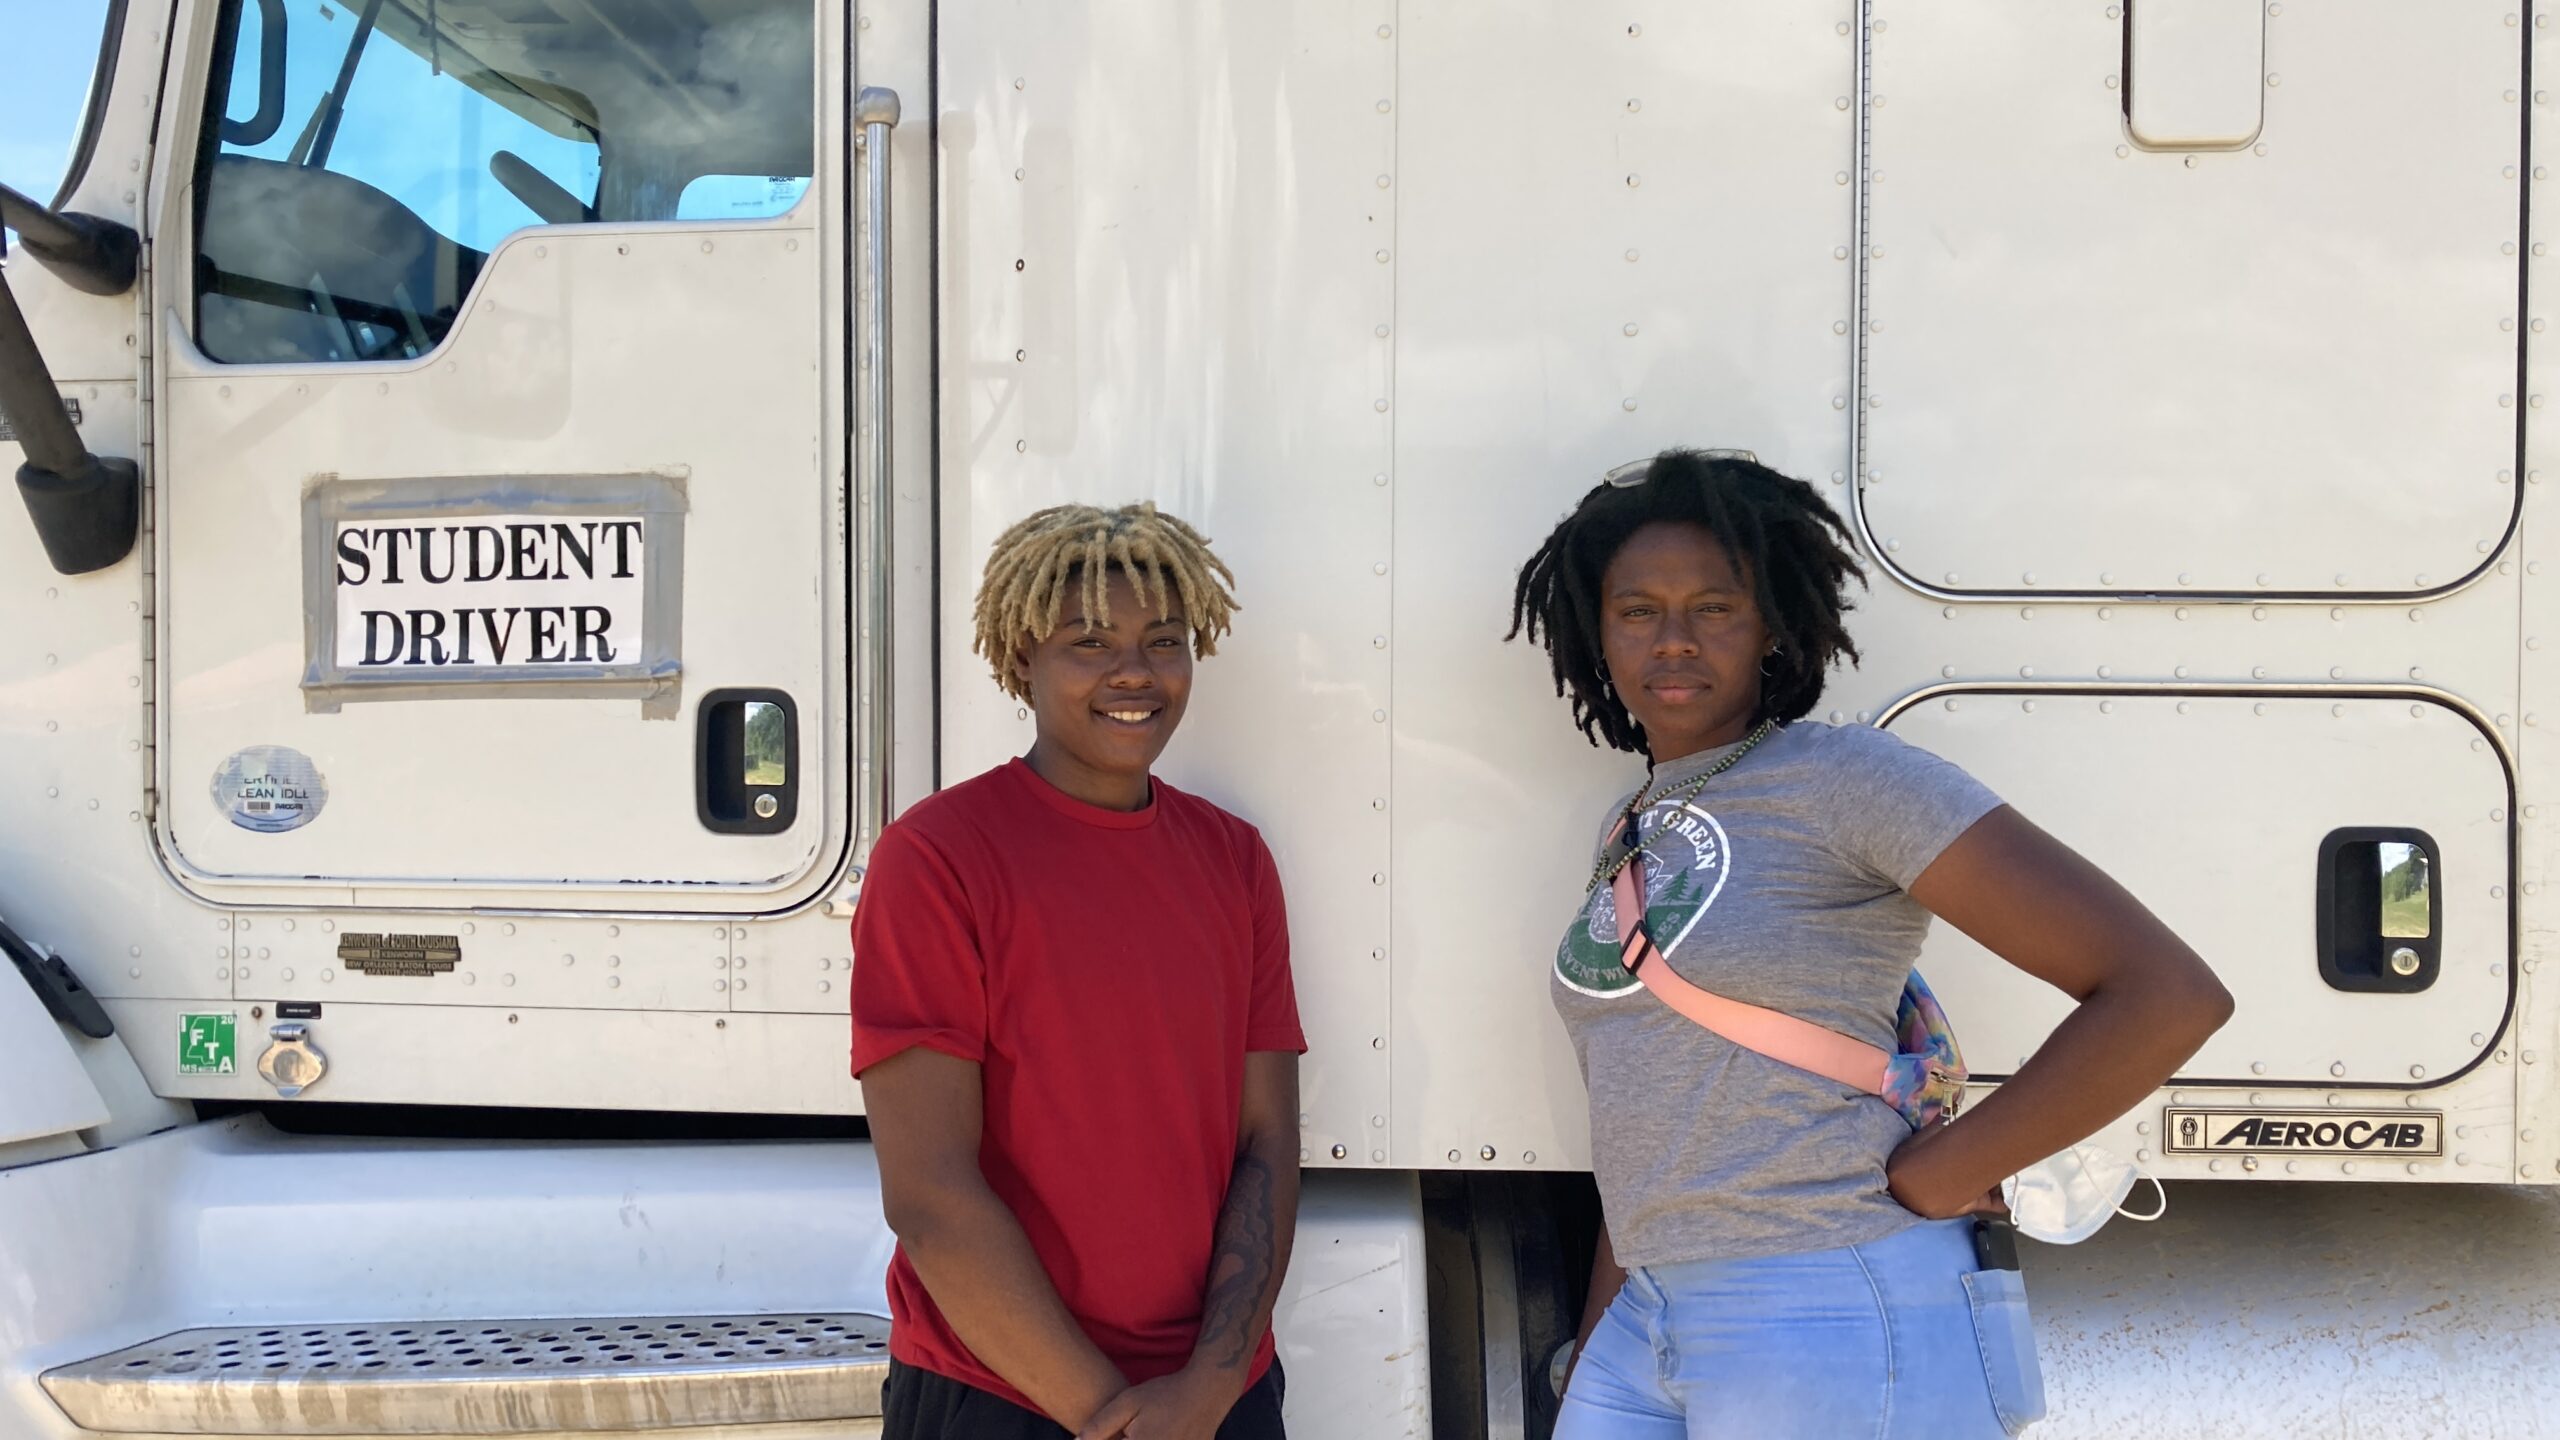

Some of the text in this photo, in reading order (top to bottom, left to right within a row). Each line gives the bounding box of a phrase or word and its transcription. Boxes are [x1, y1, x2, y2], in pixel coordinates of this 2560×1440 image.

[337, 522, 643, 586] STUDENT
[358, 606, 617, 666] DRIVER
[237, 788, 275, 799] LEAN
[1662, 810, 1718, 871] GREEN
[181, 1064, 198, 1073] MS
